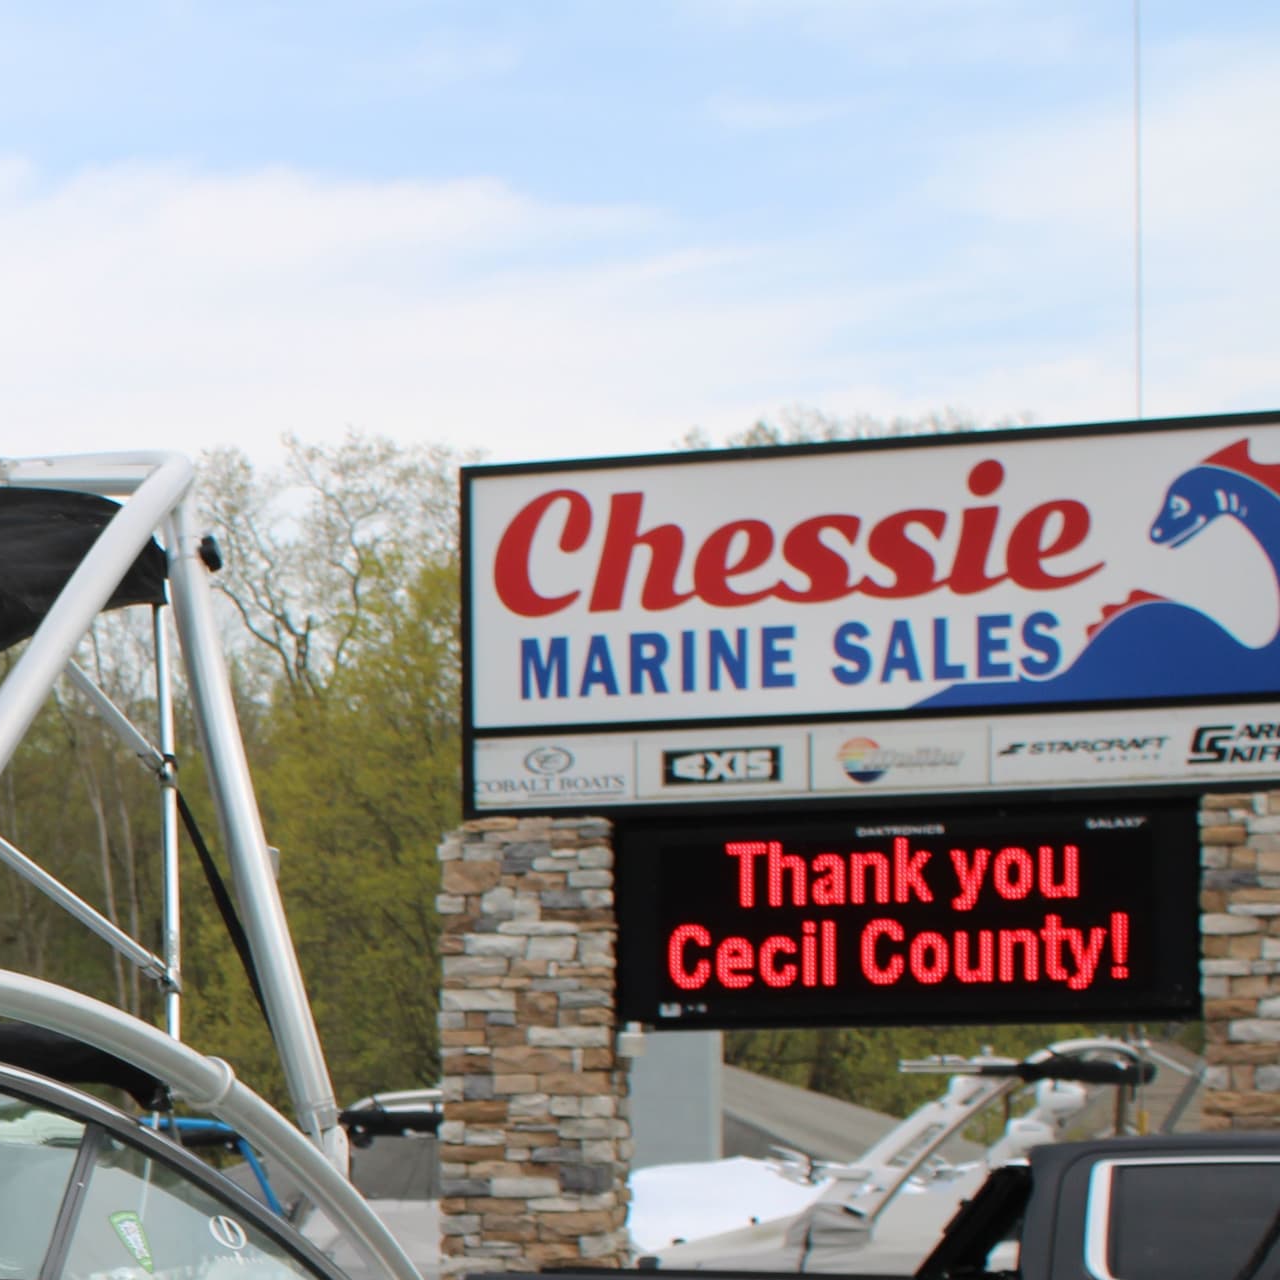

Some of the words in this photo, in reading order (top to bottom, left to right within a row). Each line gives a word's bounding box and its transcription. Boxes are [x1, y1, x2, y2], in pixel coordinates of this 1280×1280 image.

[493, 458, 1107, 618] Chessie
[519, 624, 797, 701] MARINE
[830, 610, 1064, 686] SALES
[1028, 734, 1171, 756] STARCRAFT
[558, 773, 626, 791] BOATS
[855, 823, 946, 838] DAKTRONICS
[1085, 816, 1148, 830] GALAXY
[725, 838, 933, 909] Thank
[950, 844, 1081, 912] you
[666, 921, 839, 991] Cecil
[859, 912, 1131, 992] County!
